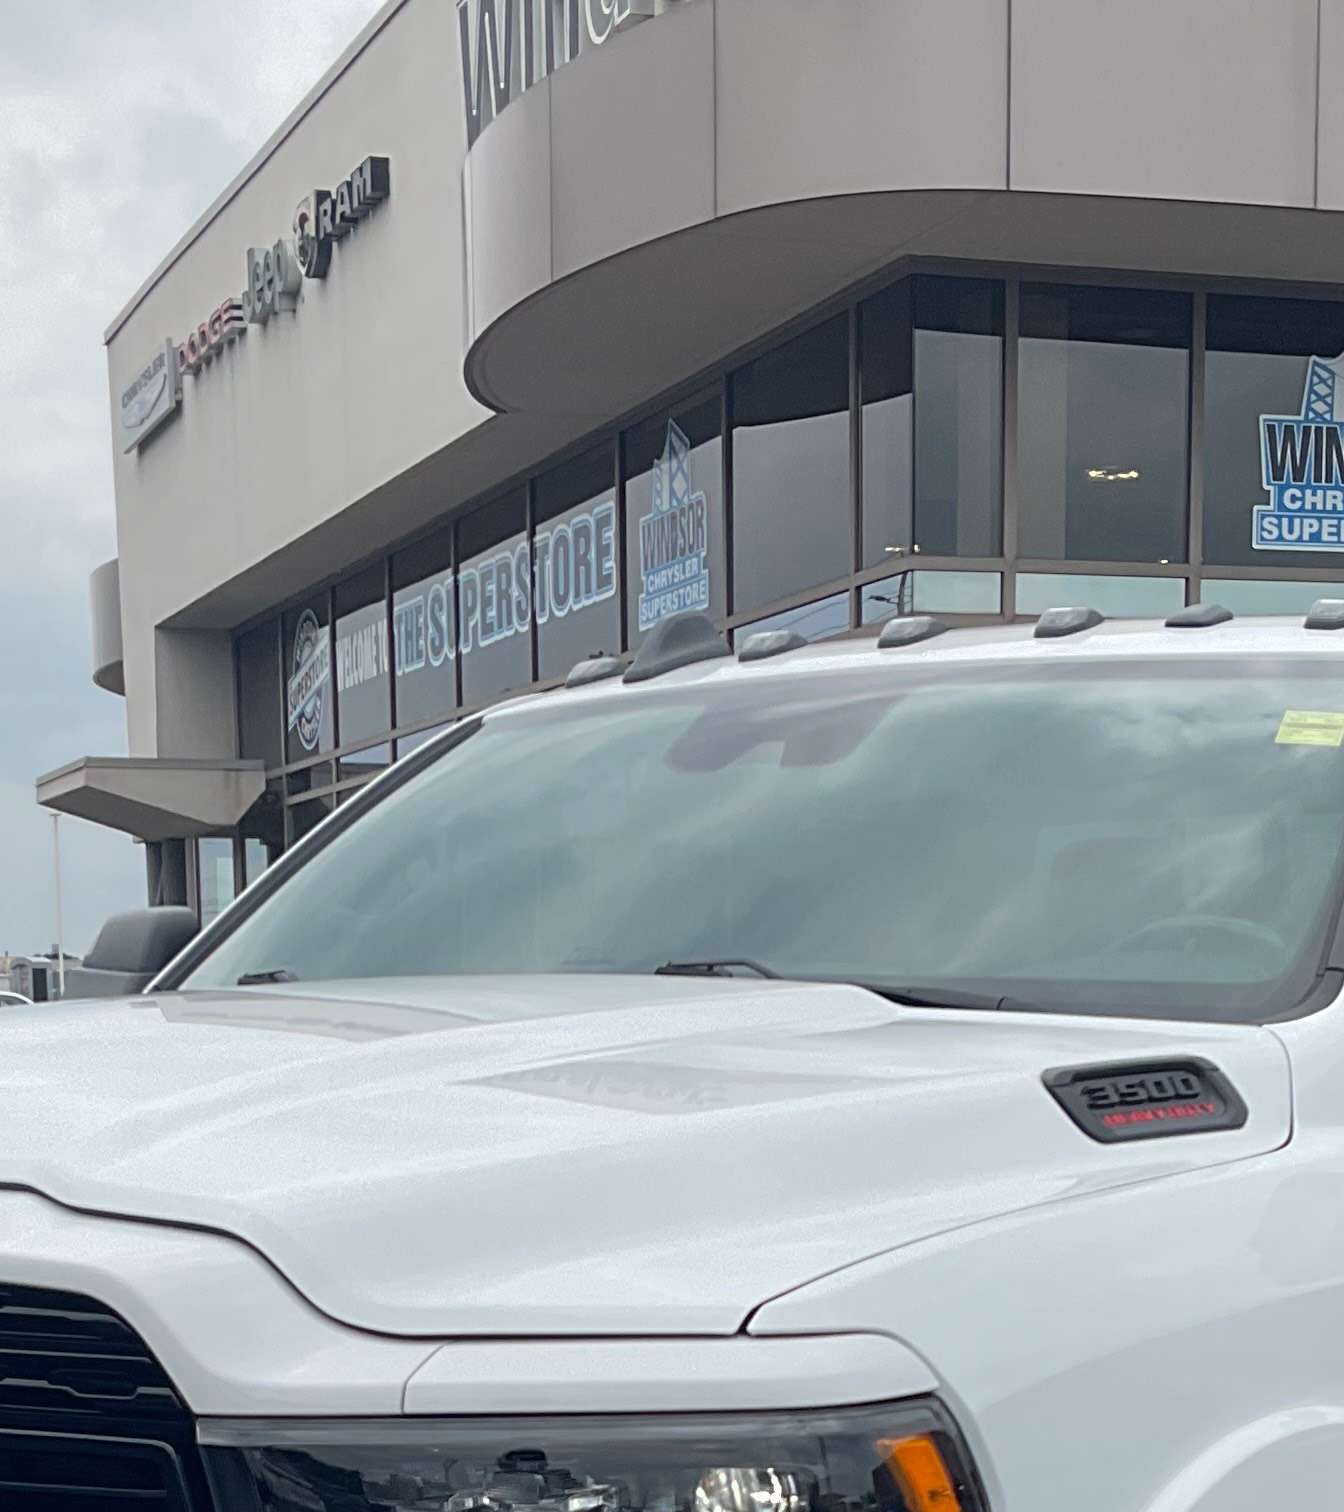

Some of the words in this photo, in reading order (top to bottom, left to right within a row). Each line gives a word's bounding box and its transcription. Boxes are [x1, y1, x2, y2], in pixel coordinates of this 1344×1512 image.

[318, 156, 390, 241] RAM
[242, 238, 299, 321] Jeep
[176, 297, 248, 371] DODGE
[641, 499, 705, 573] WINDSOR
[640, 579, 706, 622] SUPERSTORE
[647, 557, 699, 593] CHRYSLER
[395, 597, 425, 675] THE
[1081, 1071, 1202, 1111] 3500
